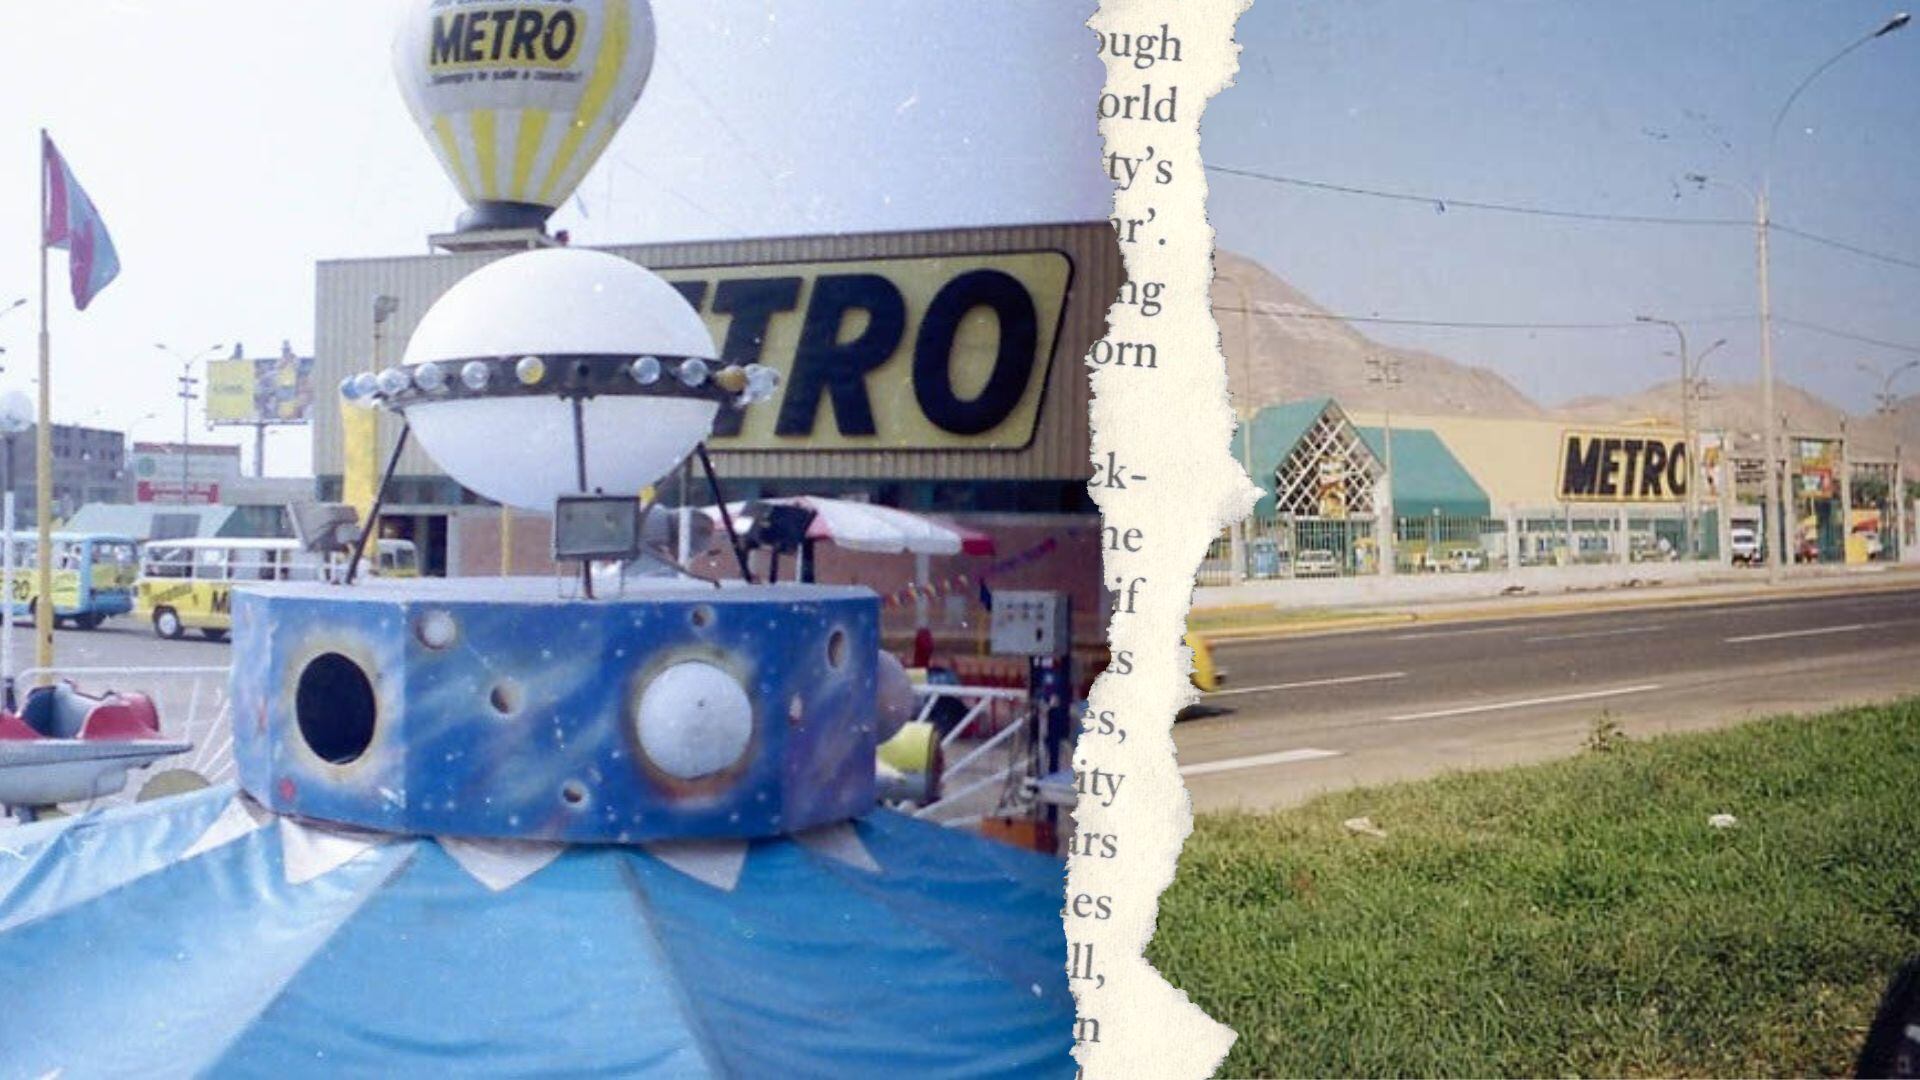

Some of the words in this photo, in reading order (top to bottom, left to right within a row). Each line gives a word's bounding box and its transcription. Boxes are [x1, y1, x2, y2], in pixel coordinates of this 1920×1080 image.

[431, 9, 576, 65] METRO
[672, 267, 1038, 437] TRO
[1562, 436, 1694, 496] METRO
